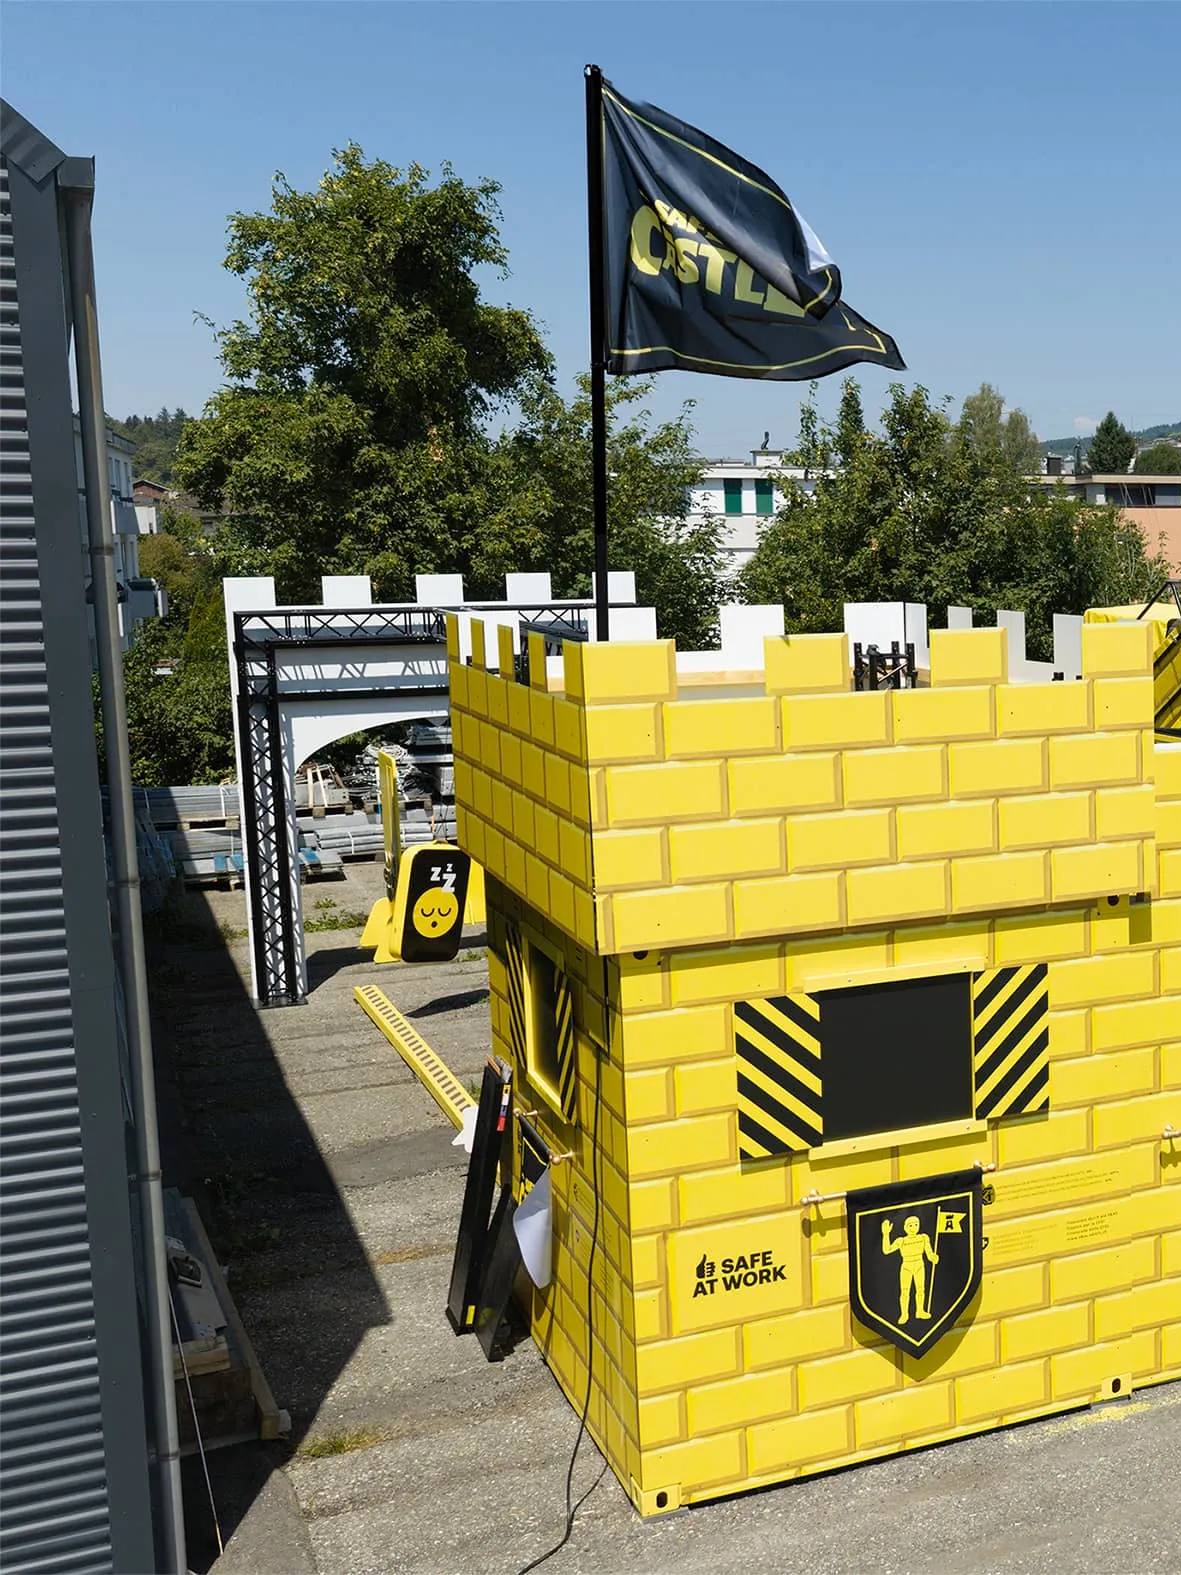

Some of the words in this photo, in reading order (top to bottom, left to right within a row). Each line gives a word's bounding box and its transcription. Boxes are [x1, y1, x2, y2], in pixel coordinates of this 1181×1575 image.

[721, 1250, 773, 1274] SAFE
[692, 1279, 718, 1298] AT
[722, 1264, 787, 1291] WORK
